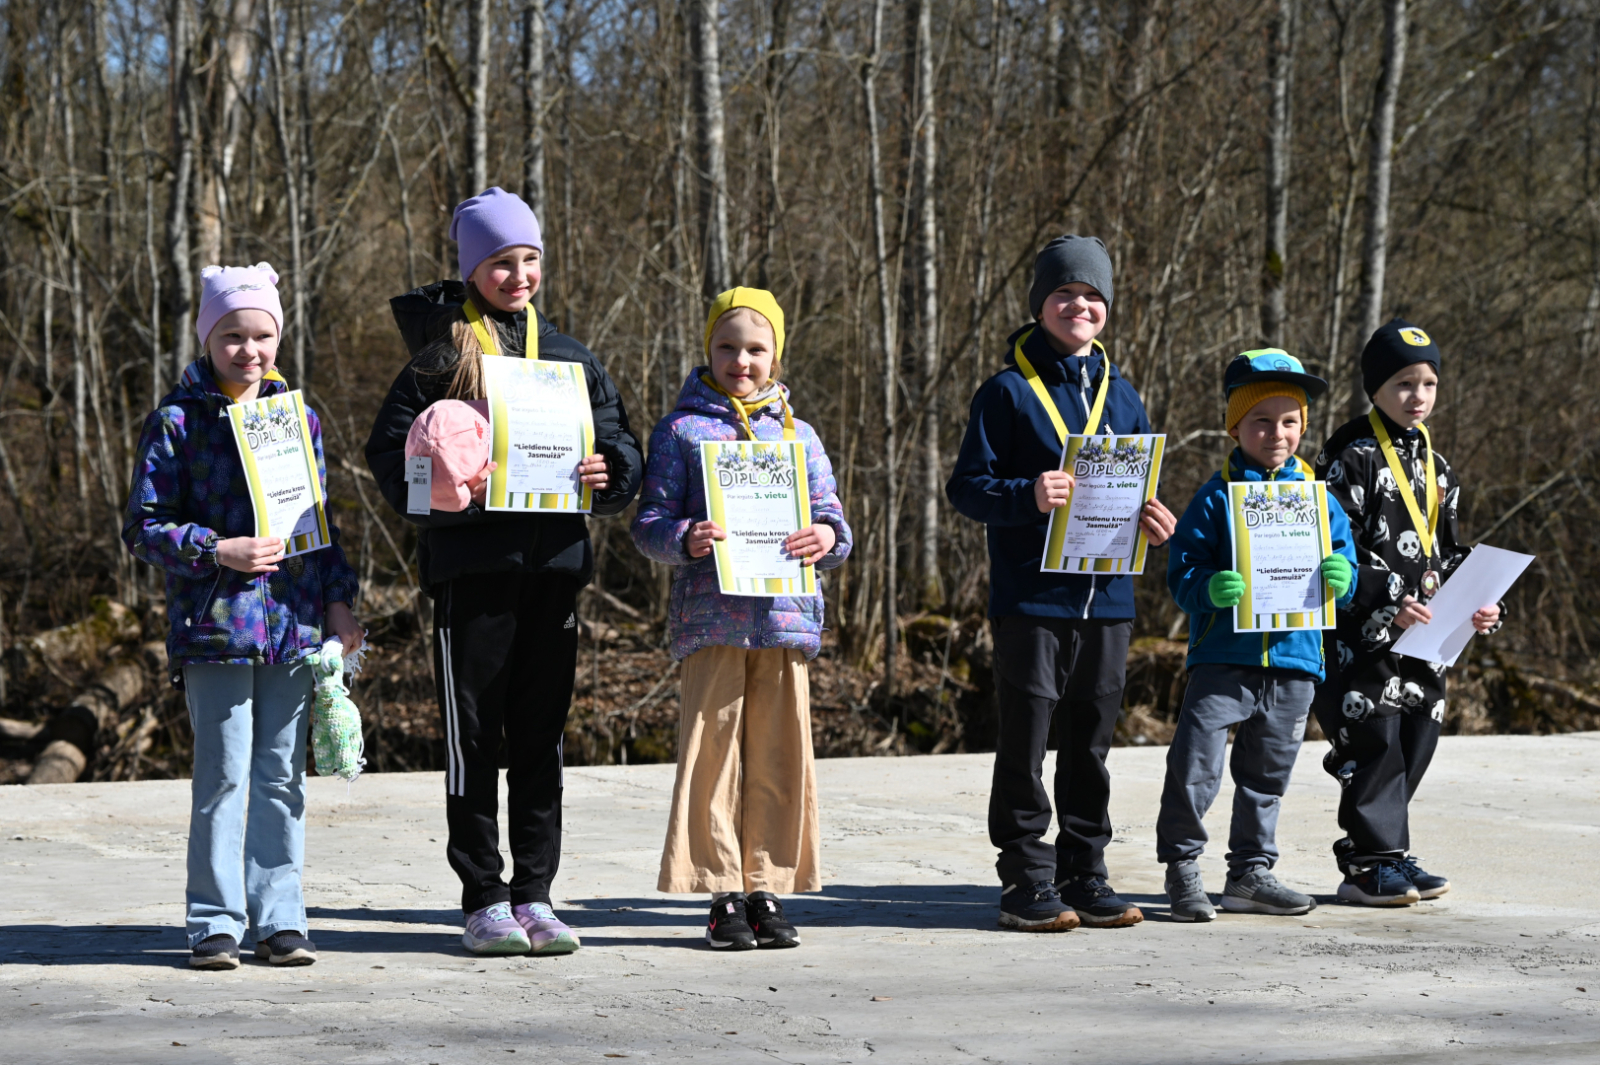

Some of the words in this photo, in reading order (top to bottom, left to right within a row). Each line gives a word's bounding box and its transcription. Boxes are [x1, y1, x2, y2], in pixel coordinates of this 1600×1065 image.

[247, 421, 300, 450] DIPLOMS
[283, 446, 299, 455] vietu
[553, 444, 573, 452] kross
[1074, 461, 1148, 477] DIPLOMS
[719, 469, 793, 487] DIPLOMS
[1116, 480, 1138, 488] vietu
[764, 491, 788, 499] vietu
[1246, 508, 1316, 527] DIPLOMS
[1289, 529, 1310, 537] vietu
